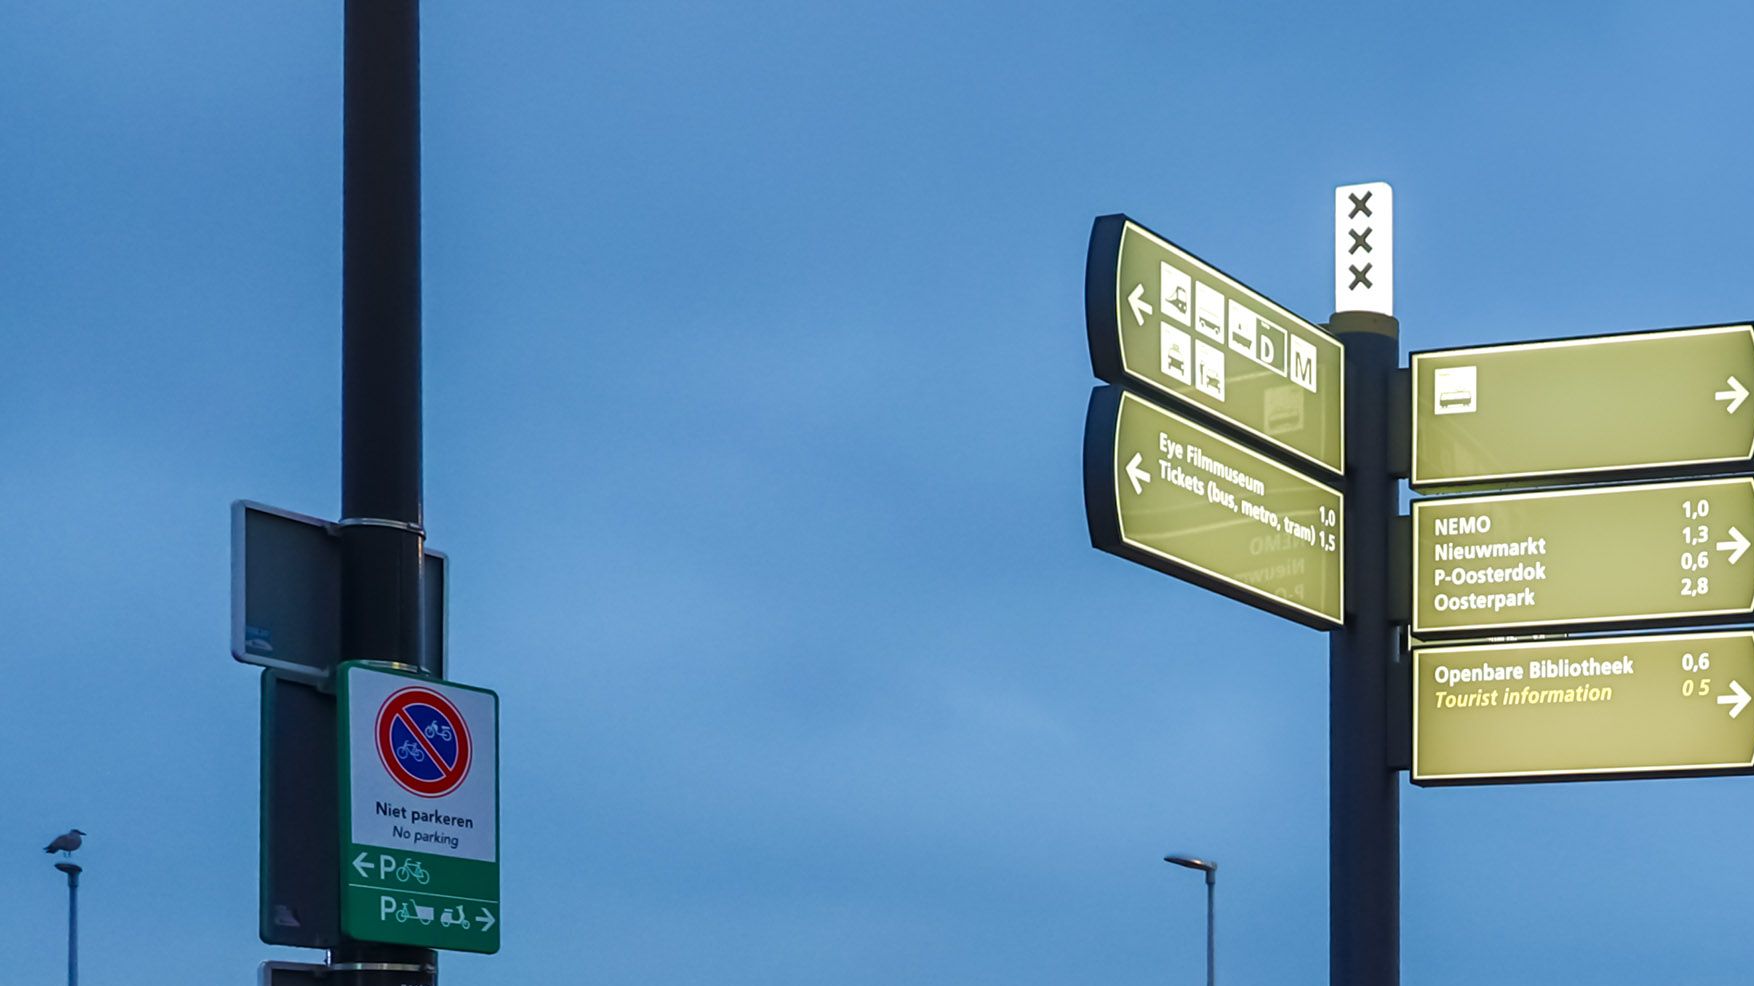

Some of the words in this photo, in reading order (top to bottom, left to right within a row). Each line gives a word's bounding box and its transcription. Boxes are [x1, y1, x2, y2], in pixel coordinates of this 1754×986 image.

[1260, 334, 1275, 364] D
[1295, 351, 1312, 385] M
[1159, 432, 1183, 459] Eye
[1187, 444, 1264, 496] Filmmuseum
[1158, 459, 1205, 496] Tickets
[1207, 480, 1238, 512] (bus,
[1241, 500, 1281, 531] metro,
[1284, 516, 1316, 546] tram)
[1682, 499, 1709, 520] 1,0
[1319, 506, 1336, 527] 1,0
[1435, 515, 1491, 536] NEMO
[1319, 531, 1336, 552] 1,5
[1682, 525, 1709, 546] 1,3
[1434, 536, 1546, 561] Nieuwmarkt
[1434, 561, 1547, 586] P-Oosterdok
[1680, 551, 1709, 572] 0,6
[1680, 576, 1709, 597] 2,8
[1434, 587, 1536, 612] Oosterpark
[1434, 663, 1524, 687] Openbare
[1529, 655, 1634, 680] Bibliotheek
[1681, 652, 1710, 673] 0,6
[1435, 687, 1499, 709] Tourist
[1502, 682, 1613, 706] information
[376, 801, 407, 819] Niet
[411, 809, 474, 829] parkeren
[392, 825, 411, 839] No
[413, 832, 459, 849] parking
[379, 854, 396, 880] P
[380, 895, 397, 921] P
